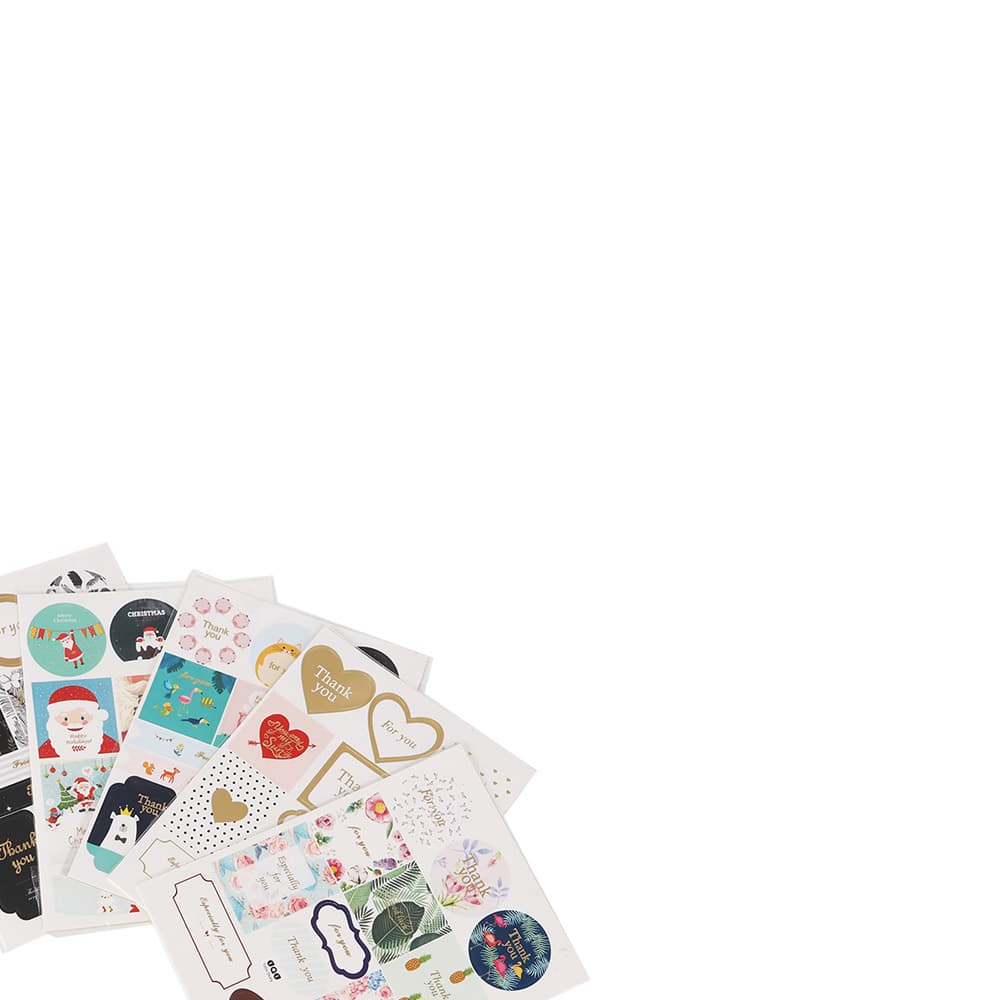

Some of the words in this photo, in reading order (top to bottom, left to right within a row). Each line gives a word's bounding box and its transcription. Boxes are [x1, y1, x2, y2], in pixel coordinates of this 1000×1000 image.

[127, 609, 166, 618] CHRISTMAS
[202, 619, 230, 636] Thank
[204, 631, 221, 642] you
[313, 664, 353, 700] Thank
[310, 683, 337, 703] you
[381, 719, 399, 736] For
[396, 733, 417, 750] you
[338, 768, 361, 792] Tha
[138, 793, 168, 812] Thank
[141, 806, 160, 816] you
[11, 853, 36, 874] you
[454, 867, 477, 893] you
[461, 853, 492, 898] Thank
[501, 940, 518, 960] you
[508, 928, 531, 964] Thank
[287, 935, 306, 964] Thank
[299, 966, 314, 984] you
[423, 981, 440, 998] you
[429, 970, 451, 1000] Thank
